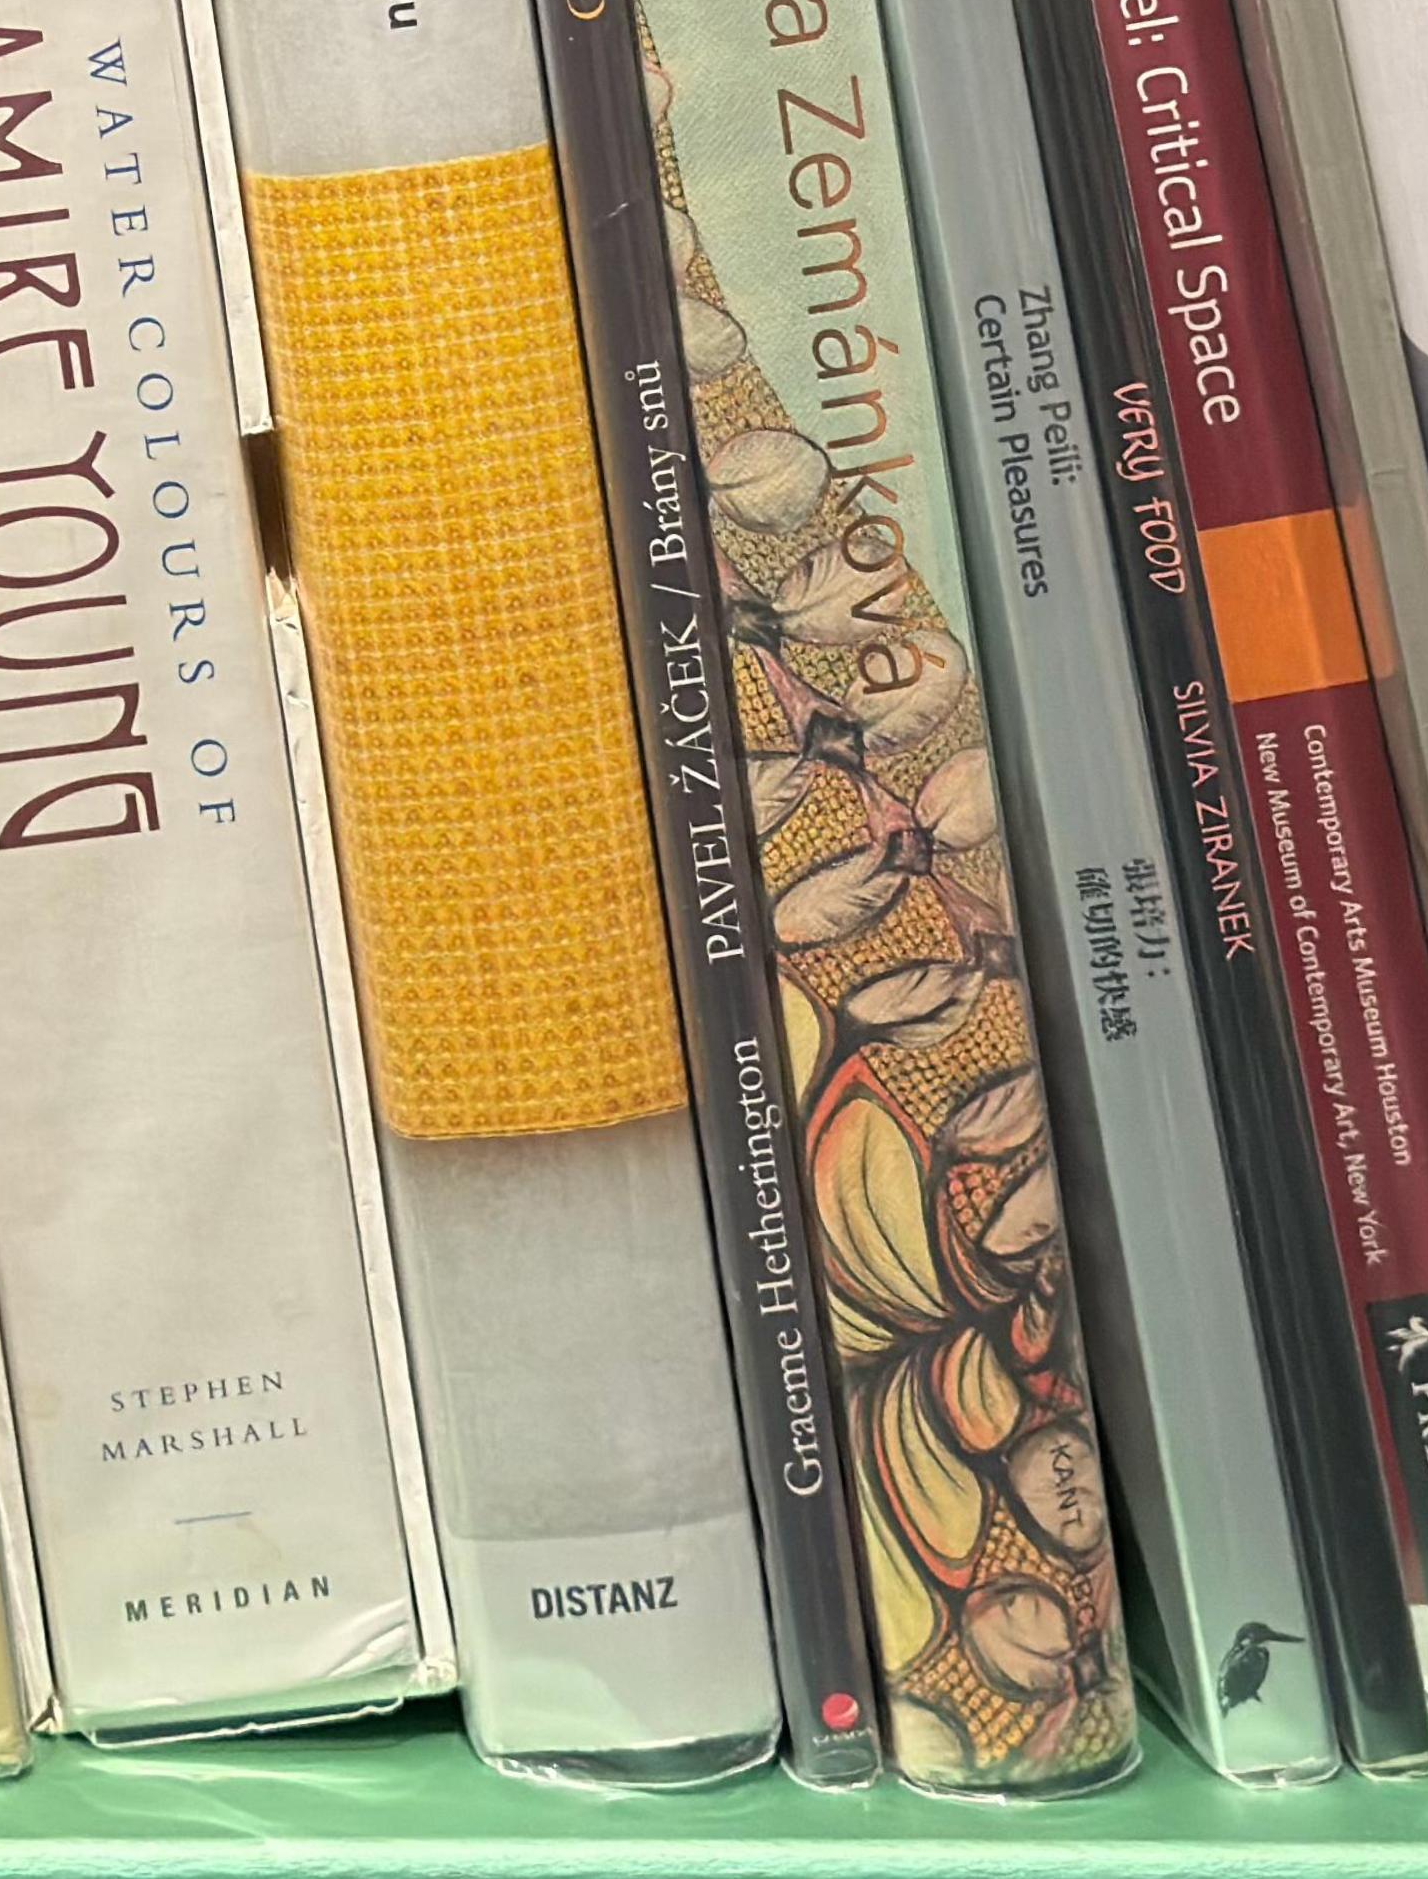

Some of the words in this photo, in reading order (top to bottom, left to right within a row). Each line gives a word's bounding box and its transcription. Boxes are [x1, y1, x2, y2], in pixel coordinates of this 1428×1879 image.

[1136, 64, 1223, 250] Critical
[776, 73, 948, 697] Zemánková
[973, 293, 1022, 424] Certain
[1017, 283, 1060, 395] Zhang
[1168, 262, 1241, 426] Space
[87, 37, 216, 684] WATERCOLOURS
[189, 737, 236, 826] OF
[1038, 399, 1083, 487] Peili:
[641, 444, 689, 567] Brány
[996, 432, 1050, 599] Pleasures
[1133, 495, 1186, 596] FOOD
[659, 612, 722, 795] ŽÁČEK
[1254, 731, 1282, 784] New
[1172, 679, 1219, 791] SILVIA
[1196, 795, 1256, 963] ZIRANEK
[1266, 788, 1304, 891] Museum
[1302, 723, 1355, 895] Contemporary
[688, 803, 746, 965] PAVEL
[1288, 893, 1318, 920] of
[1338, 900, 1368, 953] Arts
[1295, 924, 1347, 1097] Contemporary
[1351, 956, 1390, 1059] Museum
[1331, 1101, 1361, 1150] Art,
[1374, 1061, 1413, 1167] Houston
[737, 1036, 799, 1316] Hetherington
[1343, 1152, 1371, 1206] New
[1357, 1209, 1387, 1266] York
[100, 1416, 309, 1463] MARSHALL
[109, 1371, 286, 1414] STEPHEN
[776, 1327, 824, 1497] Graeme
[125, 1575, 332, 1623] MERIDIAN
[530, 1575, 679, 1621] DISTANZ
